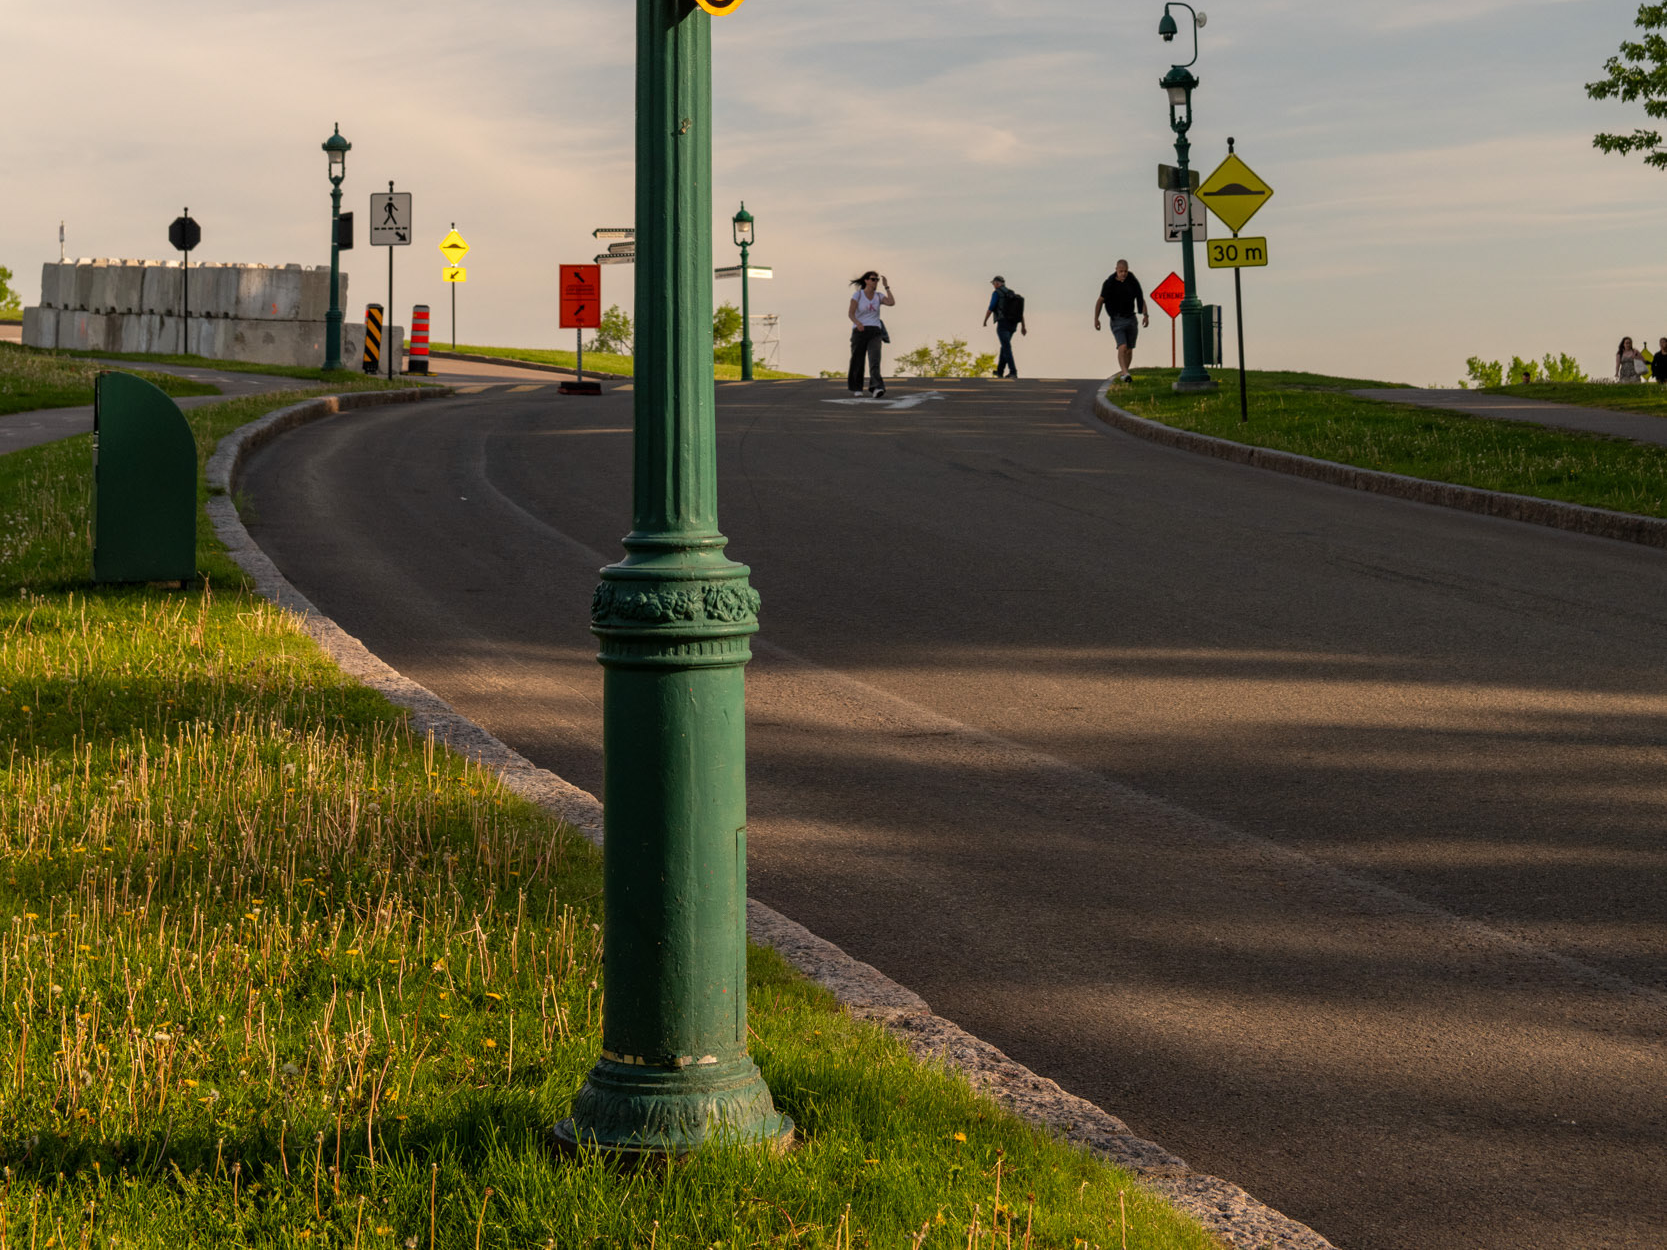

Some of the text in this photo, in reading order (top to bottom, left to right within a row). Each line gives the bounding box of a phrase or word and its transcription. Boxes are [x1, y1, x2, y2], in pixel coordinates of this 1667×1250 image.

[1213, 244, 1262, 262] 30 m
[1154, 291, 1184, 300] ÉVÉNEME
